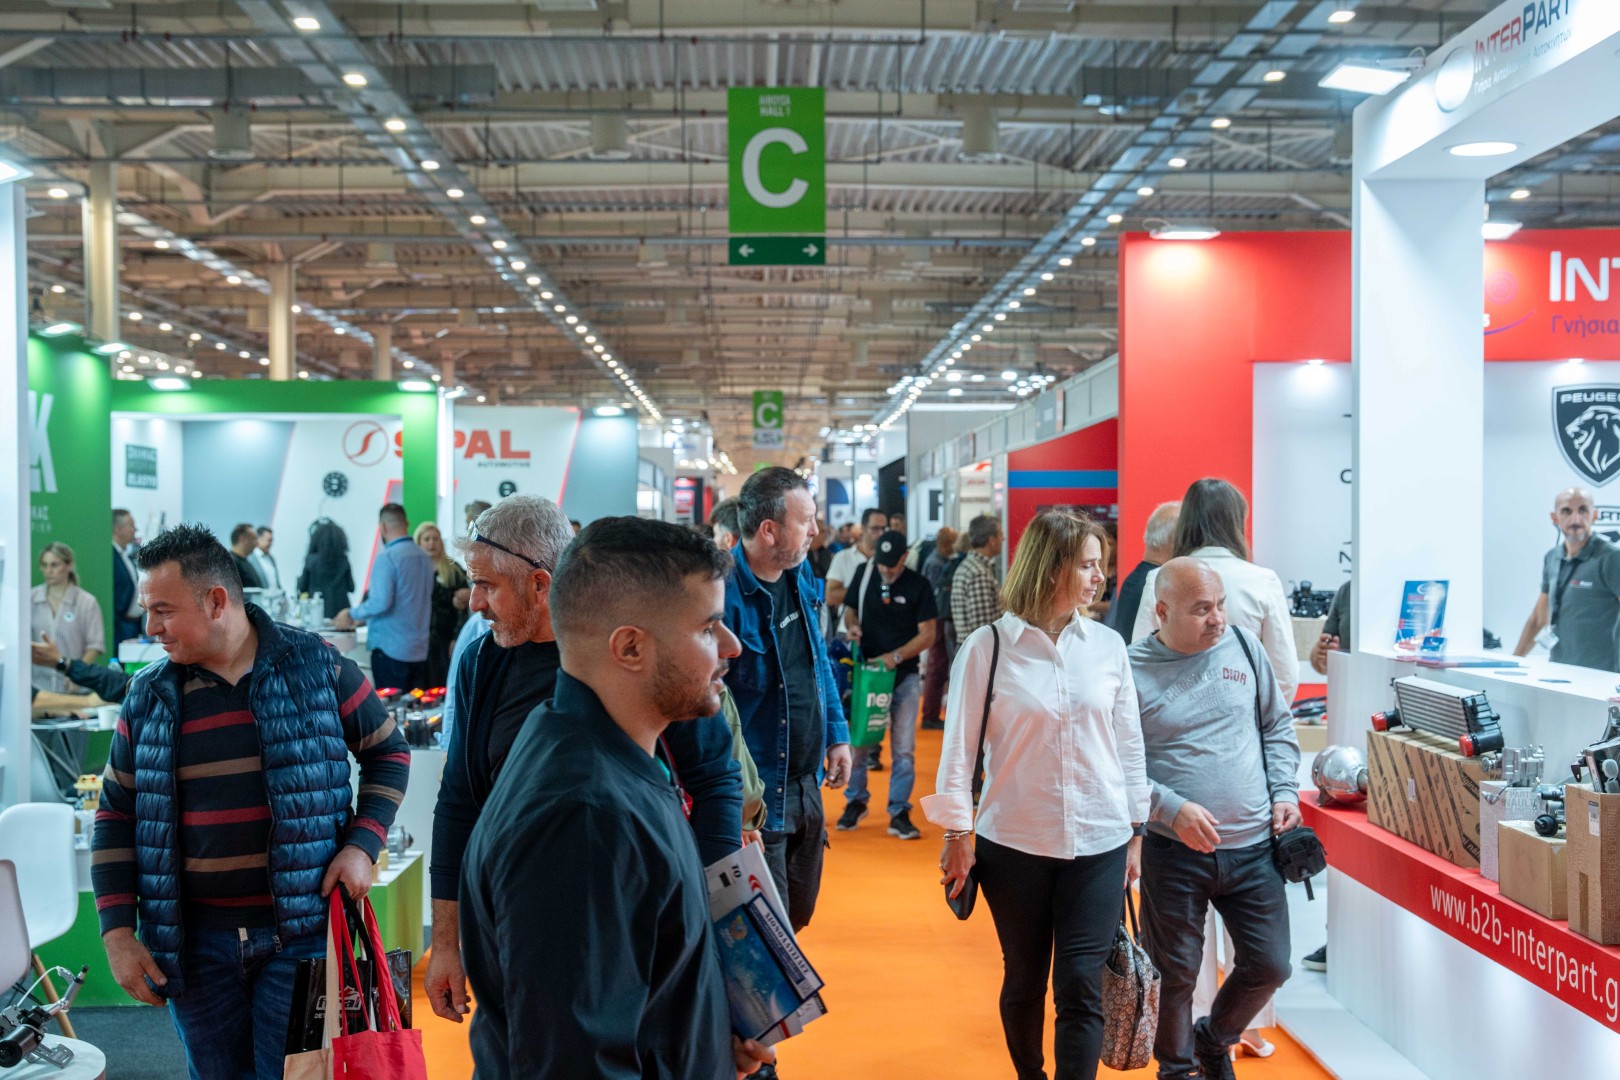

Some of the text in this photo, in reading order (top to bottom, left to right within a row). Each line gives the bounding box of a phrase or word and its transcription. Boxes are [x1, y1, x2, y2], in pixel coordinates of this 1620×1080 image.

[741, 127, 810, 209] C
[1560, 391, 1620, 405] PEUGE
[756, 402, 779, 428] C
[1222, 667, 1247, 686] DIOR
